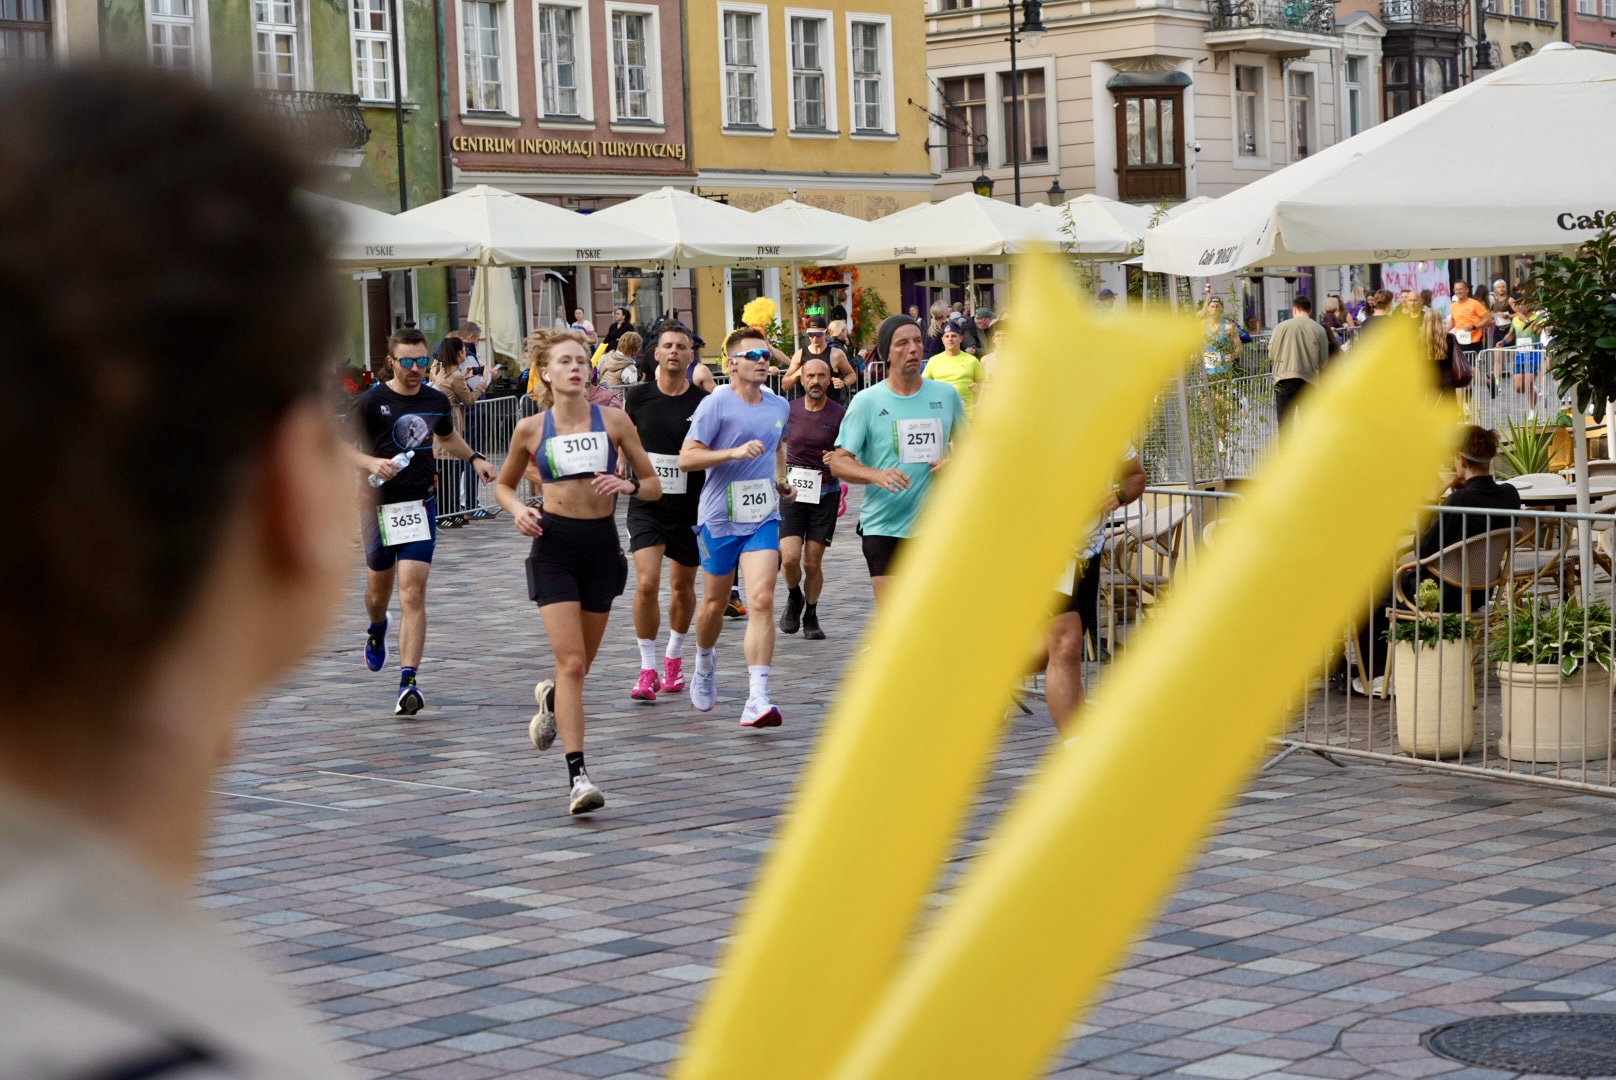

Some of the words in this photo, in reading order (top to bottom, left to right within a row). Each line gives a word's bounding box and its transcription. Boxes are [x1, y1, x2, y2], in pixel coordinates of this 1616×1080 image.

[452, 136, 516, 153] CENTRUM
[520, 138, 598, 158] INFORMACJI
[600, 141, 686, 161] TURYSTYCZNEJ
[365, 245, 394, 256] TYSKIE
[575, 249, 602, 259] TYSKIE
[757, 245, 781, 256] TYSKIE
[563, 437, 598, 454] 3101
[907, 432, 936, 446] 2571
[655, 466, 679, 478] 3311
[792, 479, 814, 489] 5532
[742, 492, 767, 506] 2161
[390, 513, 422, 528] 3635
